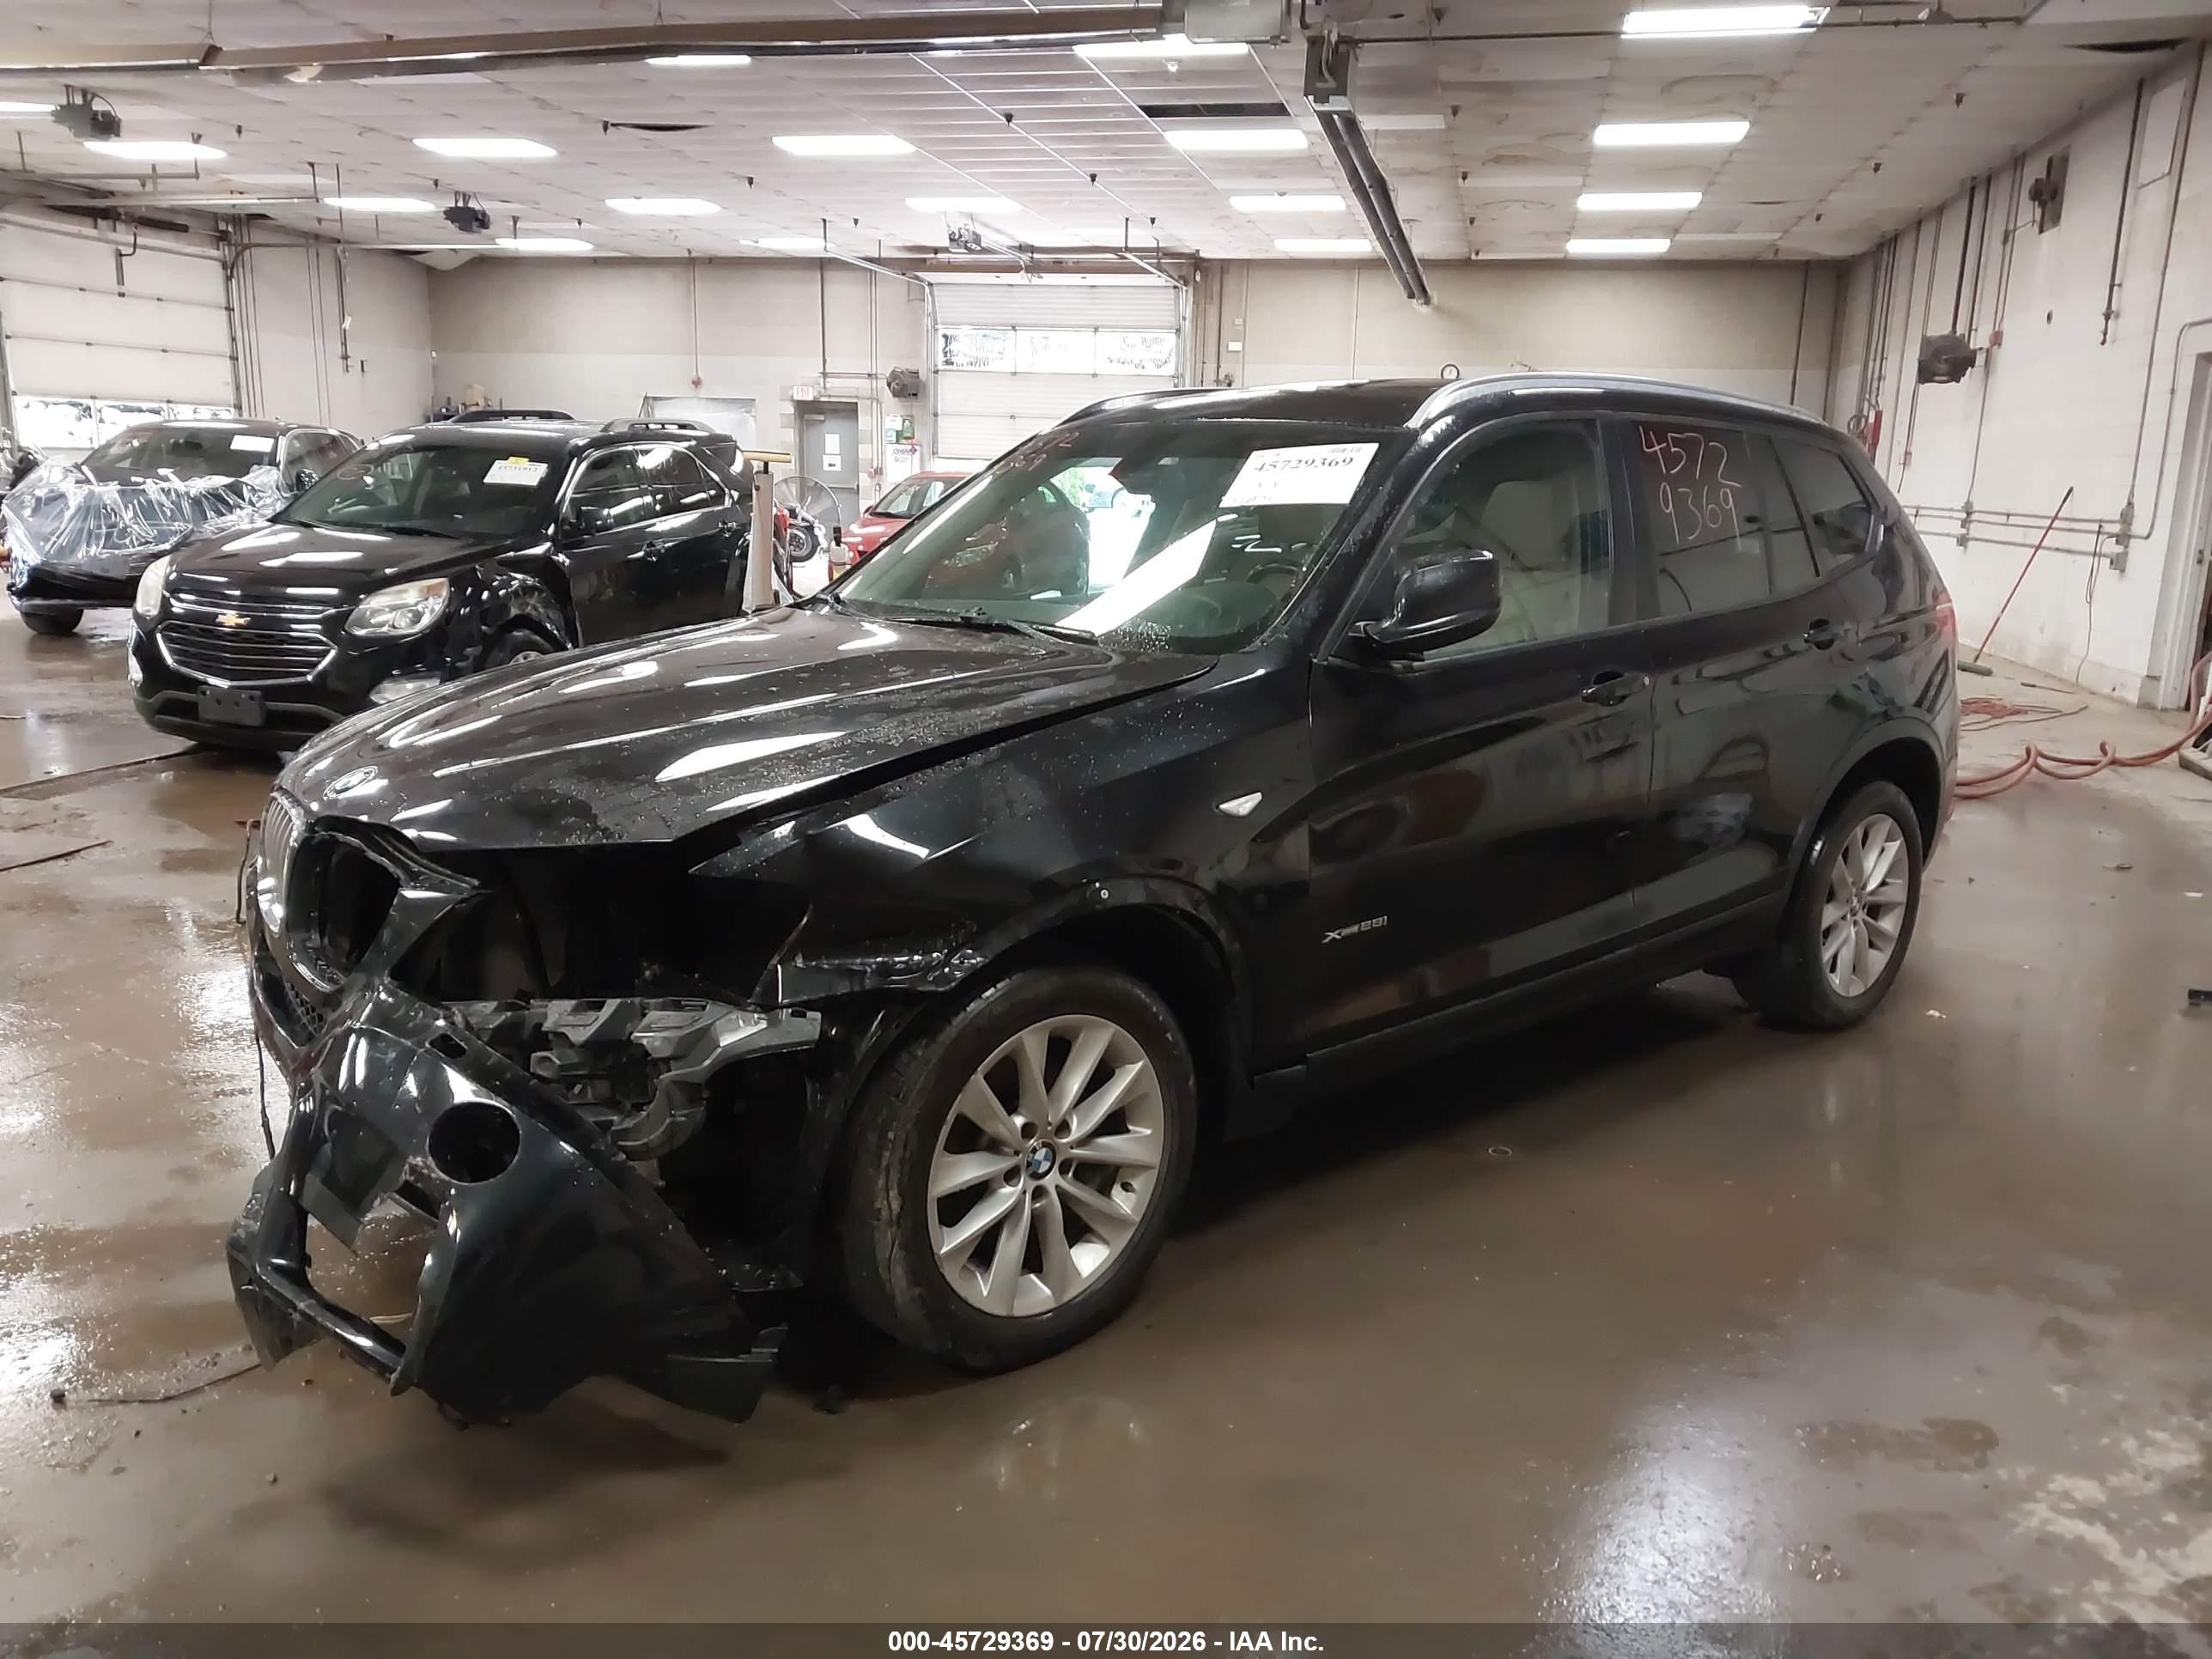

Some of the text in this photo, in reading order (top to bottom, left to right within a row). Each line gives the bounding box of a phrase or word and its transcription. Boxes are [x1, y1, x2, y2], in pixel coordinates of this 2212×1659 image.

[1254, 456, 1354, 472] 45729369
[1638, 425, 1742, 489] 4572
[1659, 481, 1742, 550] 9369
